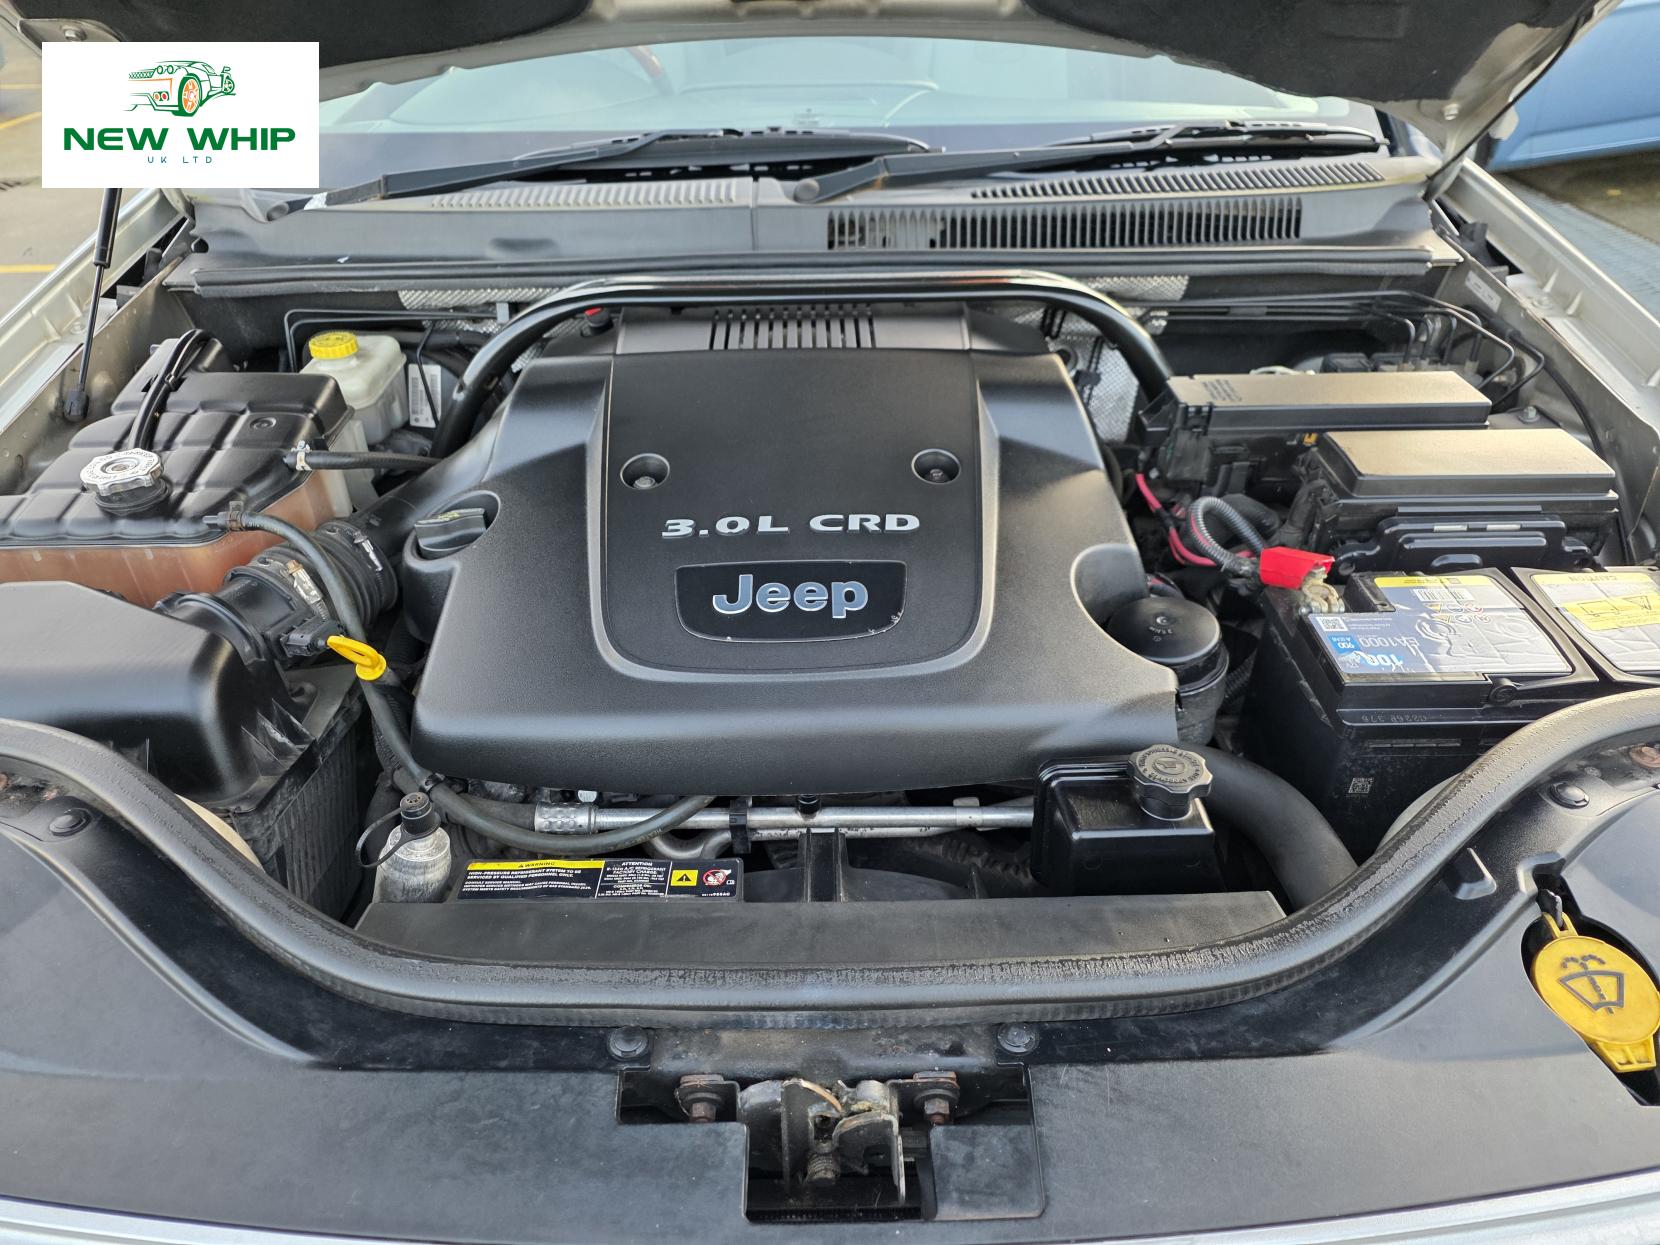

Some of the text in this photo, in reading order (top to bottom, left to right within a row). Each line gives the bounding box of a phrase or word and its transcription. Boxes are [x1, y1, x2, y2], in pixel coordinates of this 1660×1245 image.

[661, 514, 920, 539] 3.0L CRD
[712, 574, 869, 619] Jeep
